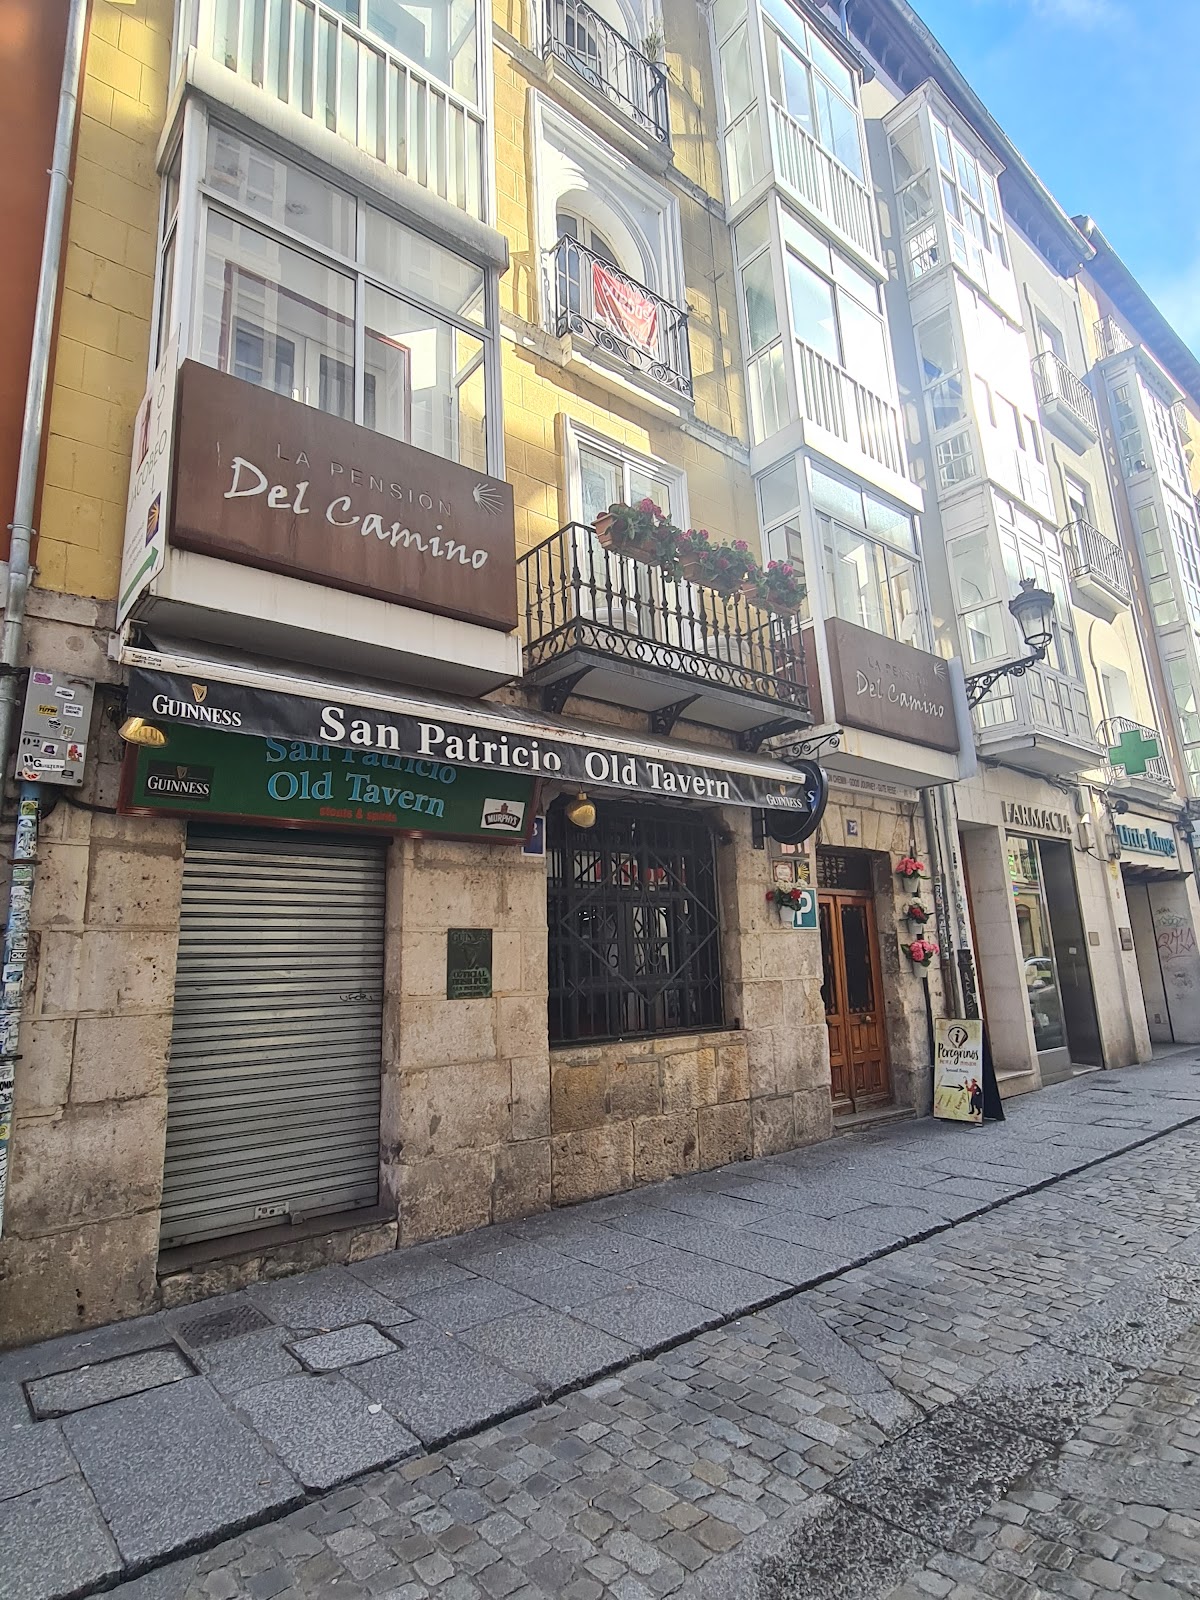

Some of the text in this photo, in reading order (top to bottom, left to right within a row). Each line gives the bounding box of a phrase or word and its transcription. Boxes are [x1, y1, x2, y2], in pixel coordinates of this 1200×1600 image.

[277, 443, 451, 516] LA PENSIÓN
[223, 456, 488, 570] Del Camino
[152, 694, 242, 727] GUINNESS
[856, 669, 944, 718] Del Camino
[319, 706, 730, 800] San Patricio Old Tavern
[147, 775, 210, 796] GUINNESS
[267, 770, 445, 818] Old Tavern
[766, 794, 803, 808] GUINNESS
[1001, 800, 1072, 835] FARMACIA
[1115, 824, 1177, 857] Little Kings
[938, 1042, 979, 1065] Peregrinos
